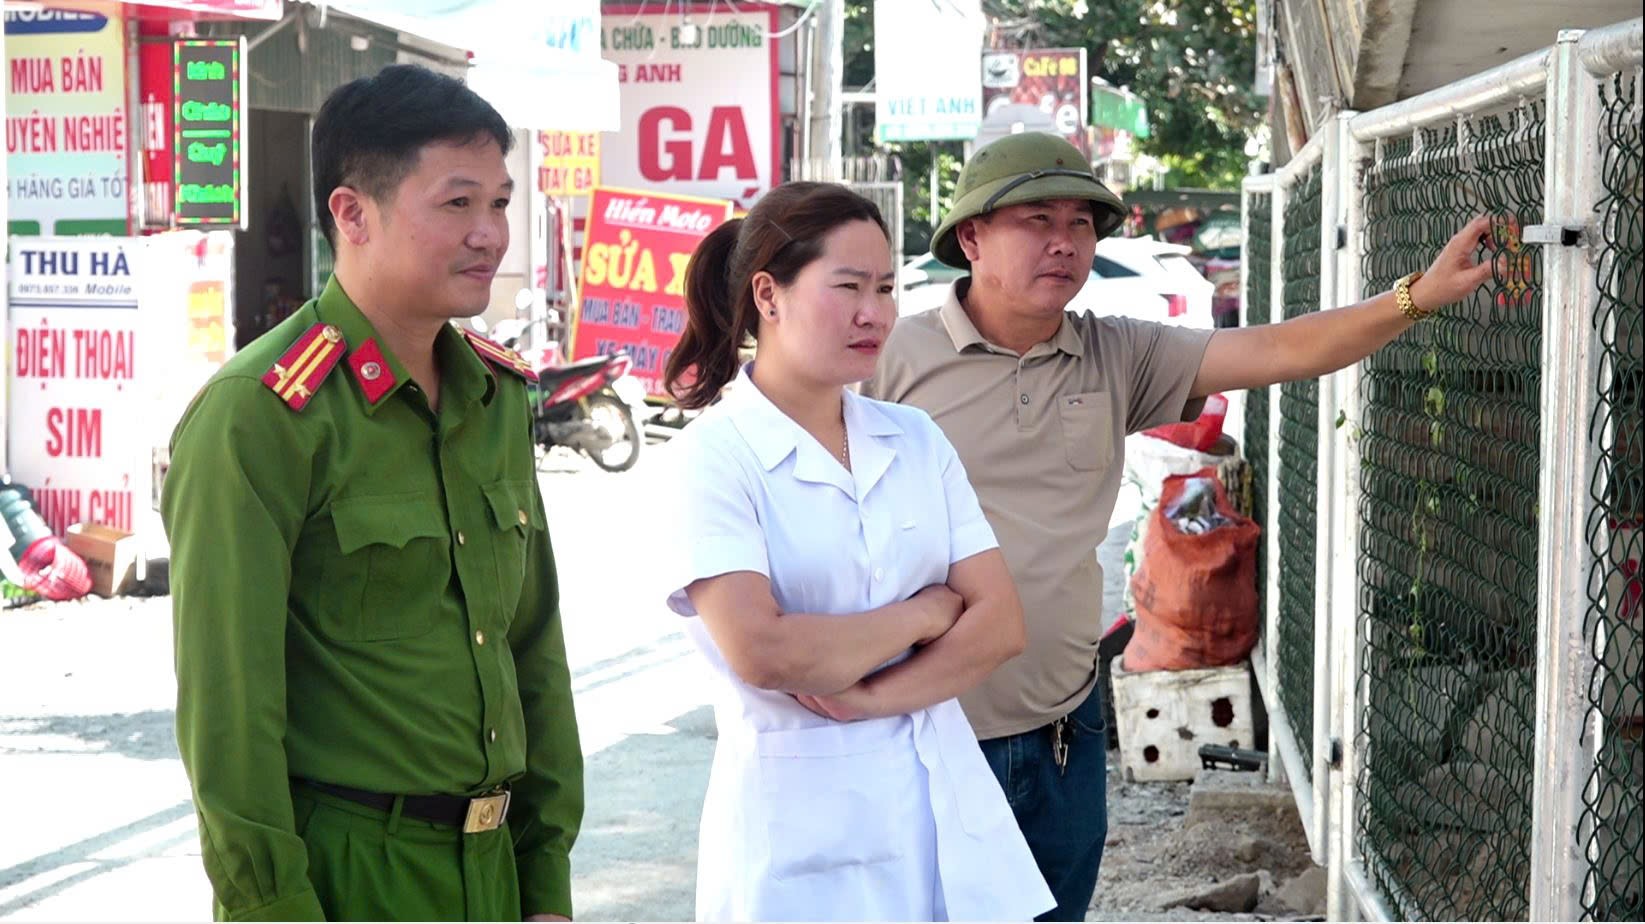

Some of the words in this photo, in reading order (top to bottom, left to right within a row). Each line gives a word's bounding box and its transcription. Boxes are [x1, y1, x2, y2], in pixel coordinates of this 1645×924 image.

[10, 57, 54, 94] MUA
[61, 48, 102, 93] BÁN
[634, 63, 682, 83] ANH
[936, 96, 975, 115] ANH
[638, 105, 758, 183] GA
[20, 250, 79, 275] THU
[90, 245, 130, 276] HÀ
[586, 229, 657, 293] SỬA
[85, 283, 132, 296] Mobile
[582, 298, 609, 322] MUA
[16, 317, 66, 390] ĐIỆN
[72, 329, 135, 392] THOẠI
[46, 406, 103, 458] SIM
